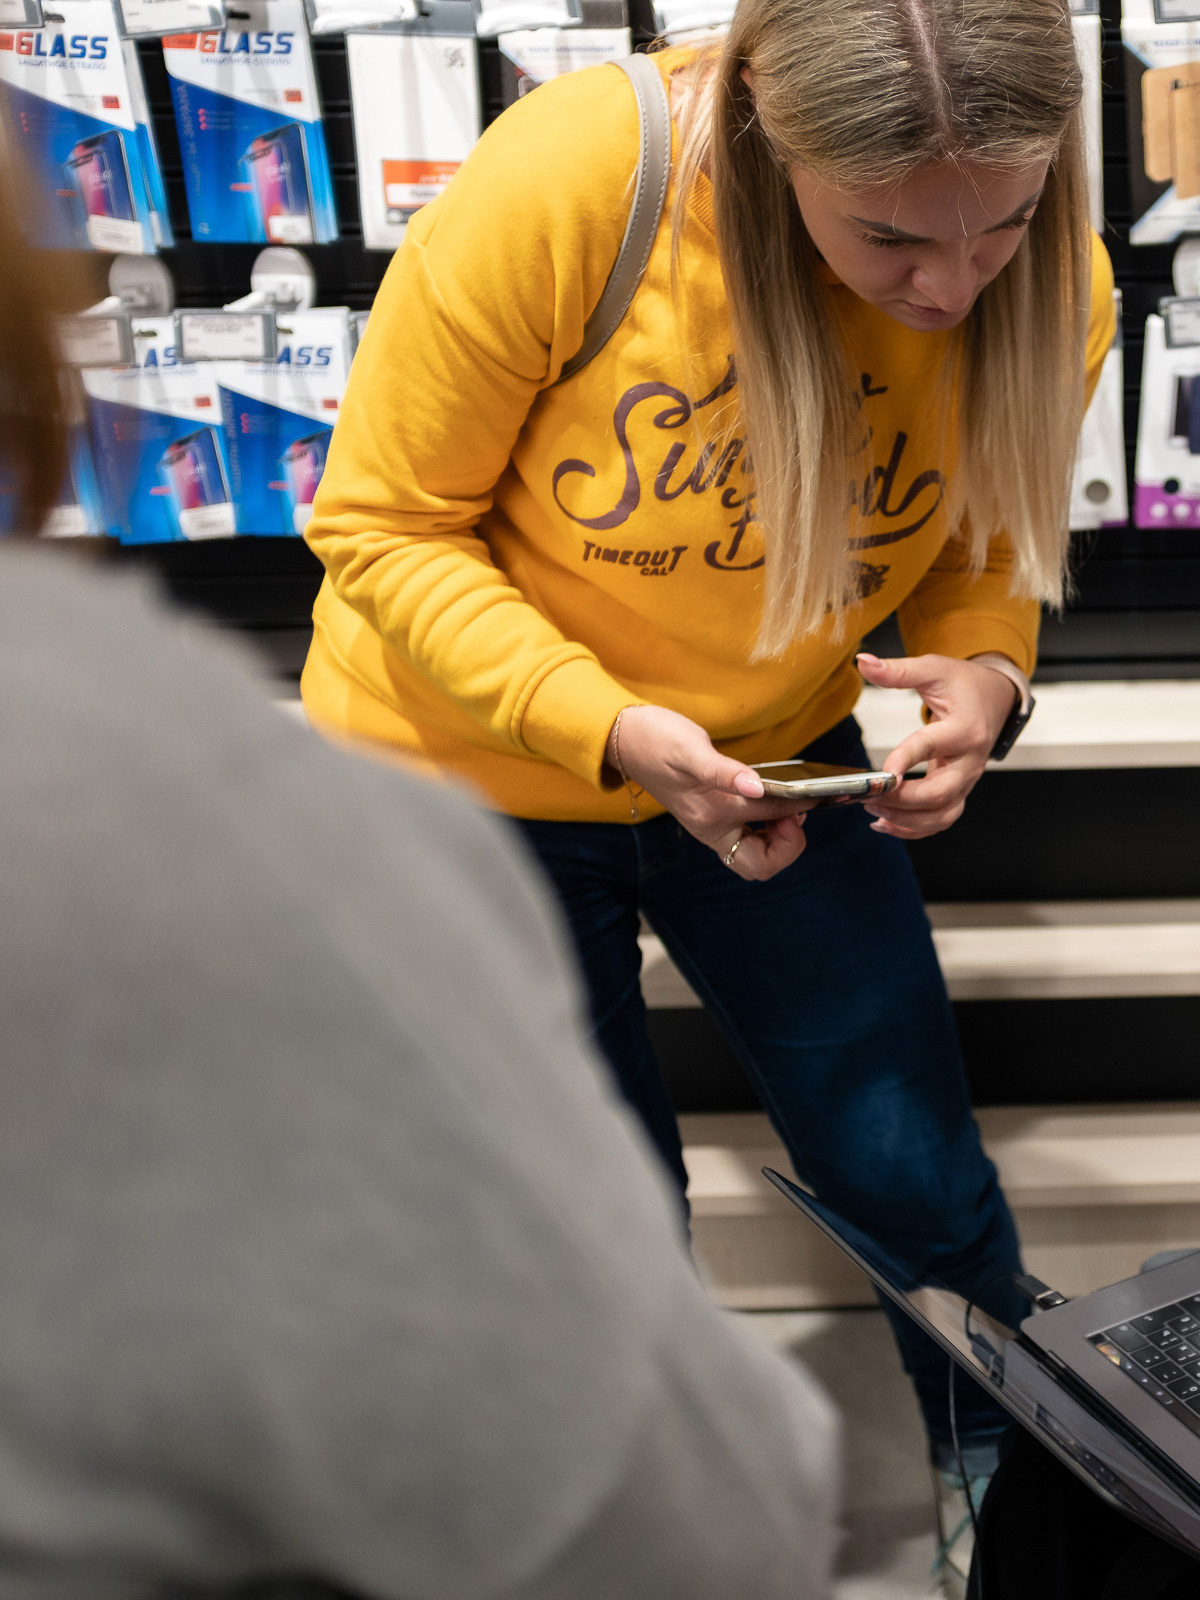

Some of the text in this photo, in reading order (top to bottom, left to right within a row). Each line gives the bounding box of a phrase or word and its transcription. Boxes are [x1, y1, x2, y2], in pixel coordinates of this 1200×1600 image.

[16, 32, 109, 59] GLASS
[199, 30, 294, 54] GLASS
[278, 346, 333, 367] ASS
[583, 540, 688, 572] TIMEOUT
[640, 567, 668, 576] CAL
